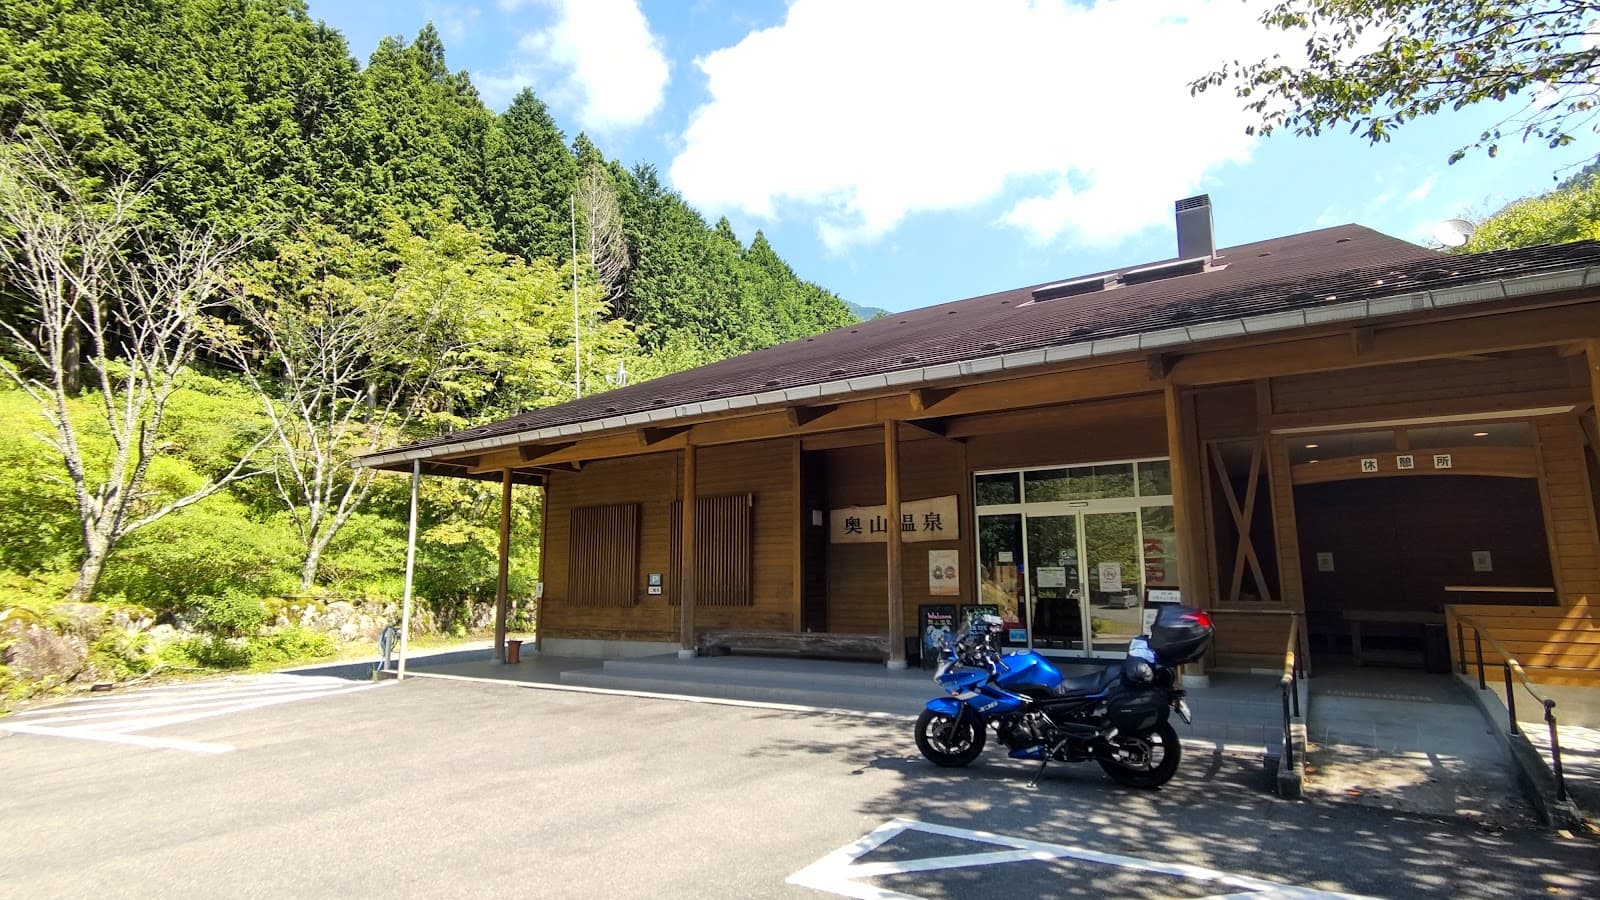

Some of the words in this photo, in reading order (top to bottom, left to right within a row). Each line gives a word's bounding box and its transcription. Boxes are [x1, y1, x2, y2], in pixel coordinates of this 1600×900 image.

[1363, 456, 1450, 471] 休憩所
[844, 511, 944, 535] 奥山温泉
